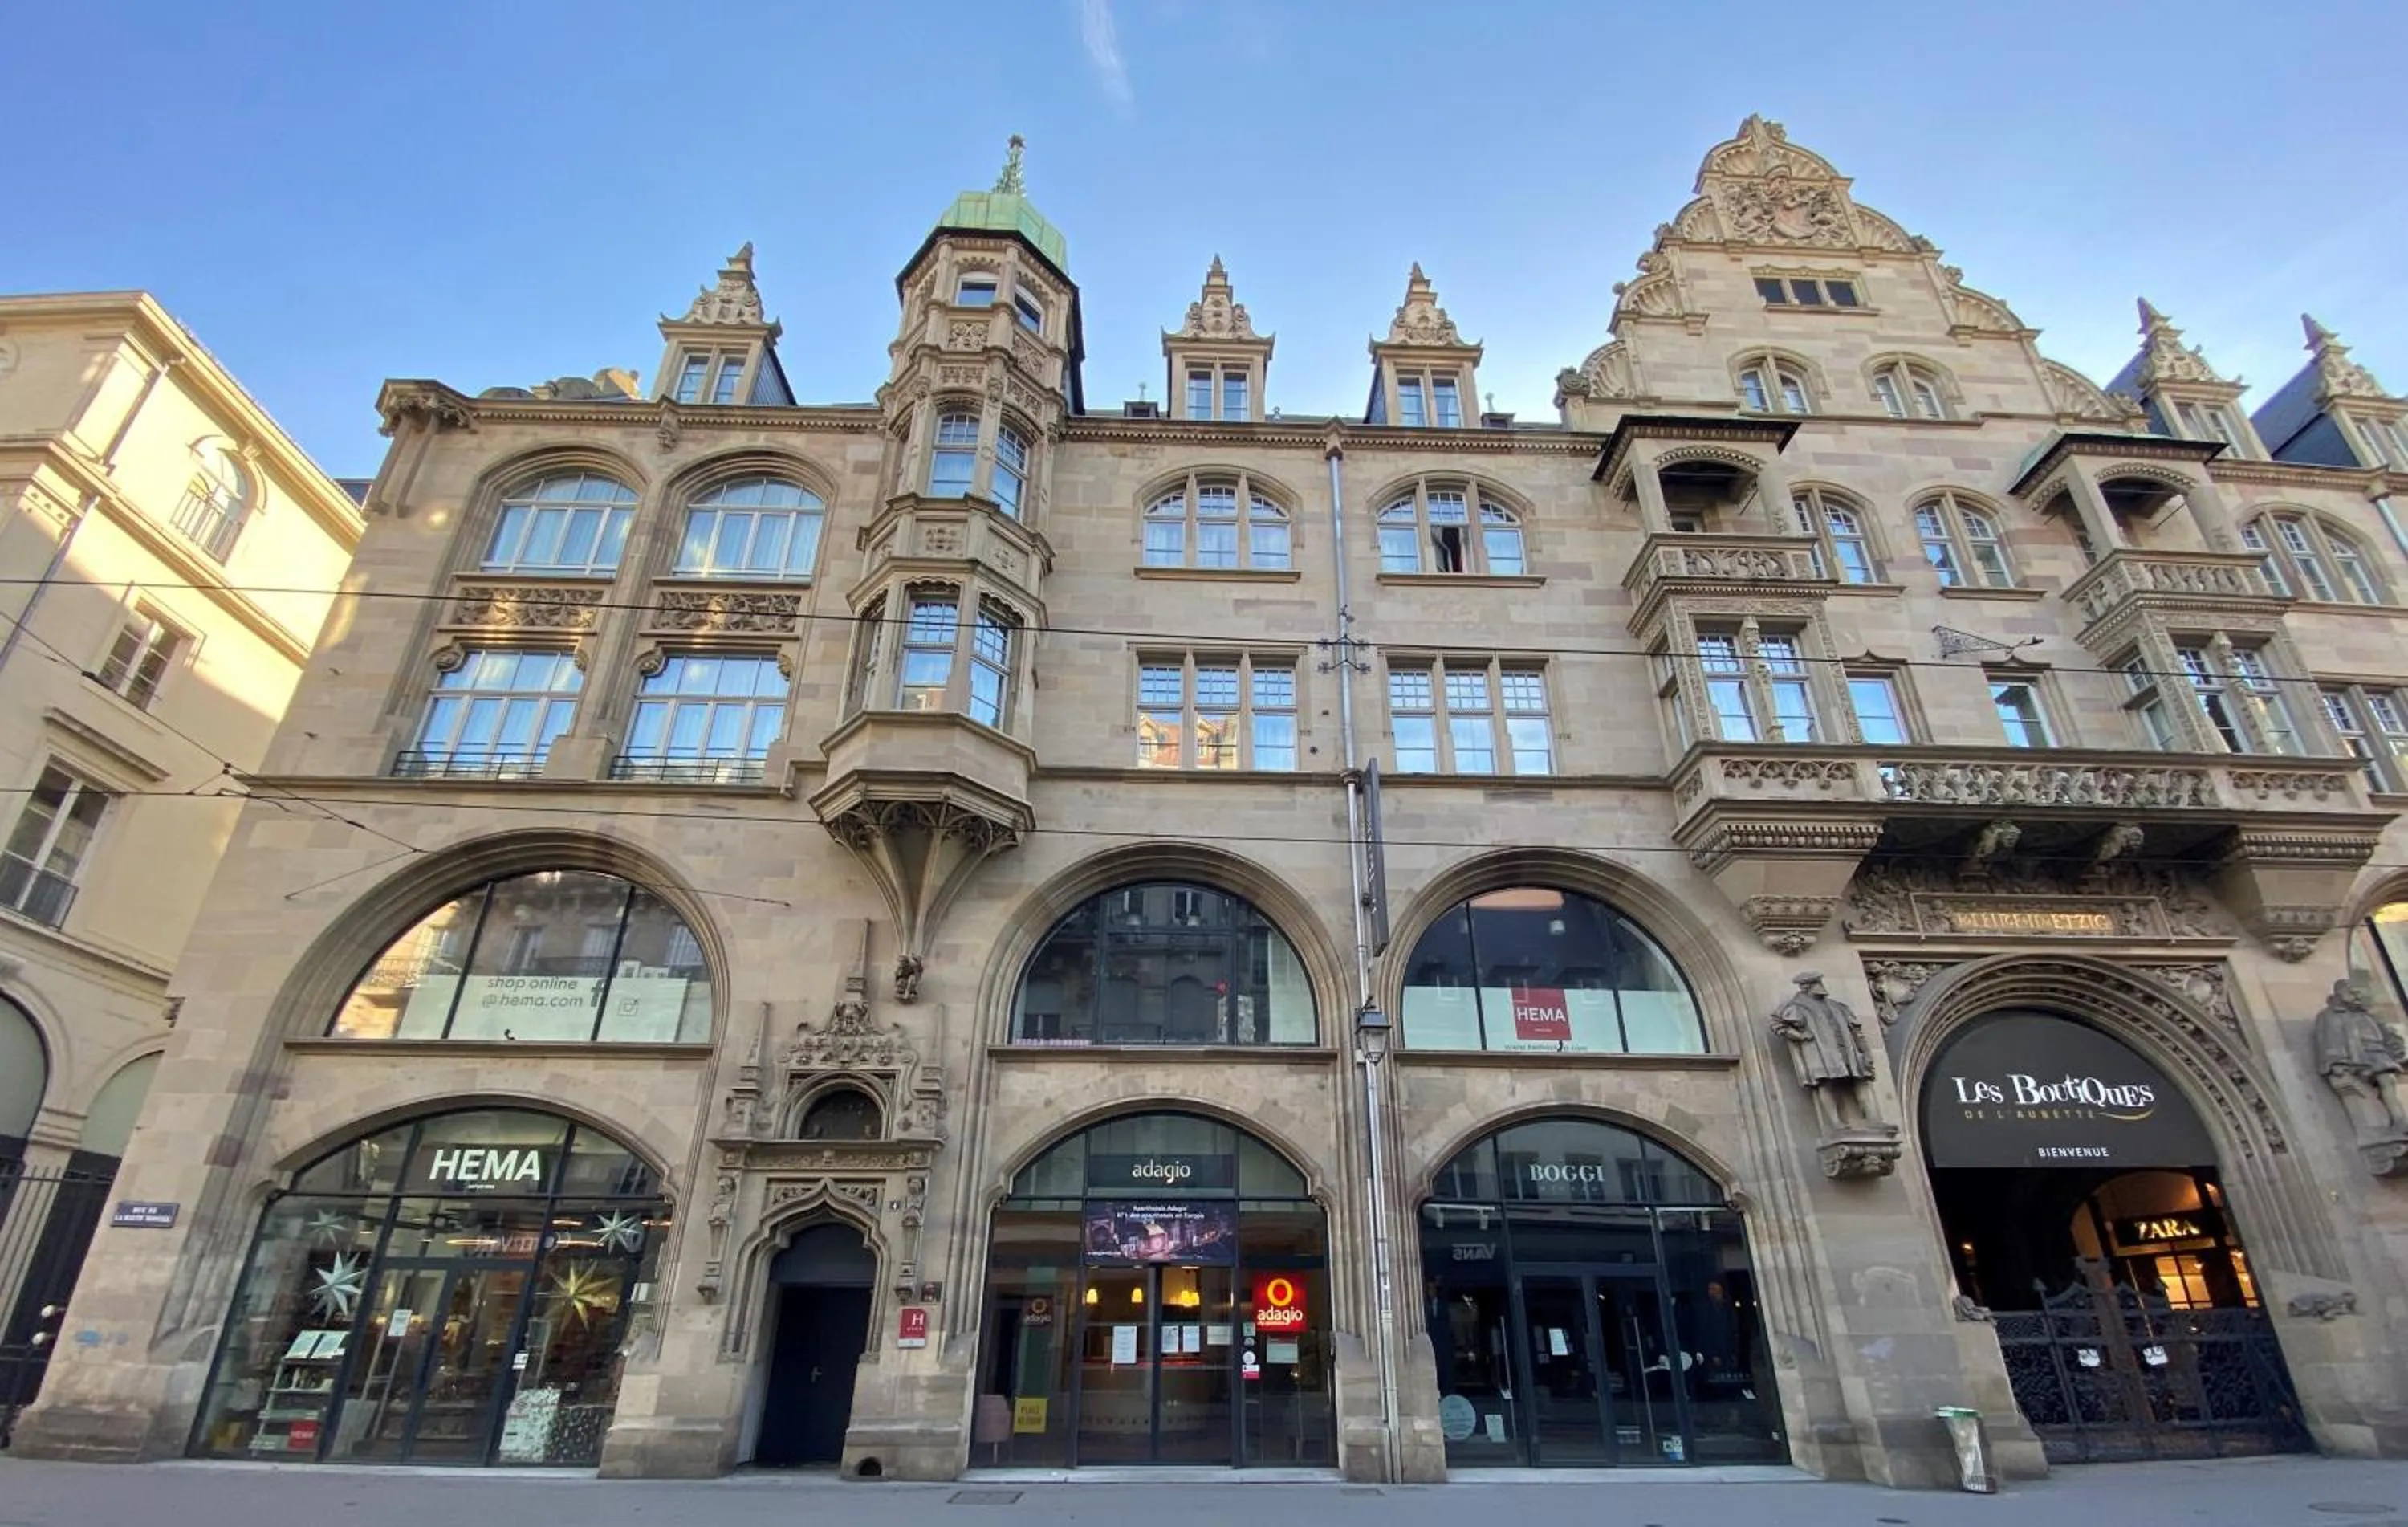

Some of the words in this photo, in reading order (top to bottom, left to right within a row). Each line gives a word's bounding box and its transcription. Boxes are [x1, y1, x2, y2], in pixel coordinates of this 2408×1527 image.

[487, 977, 526, 992] shop
[528, 977, 578, 990] online
[1516, 1007, 1566, 1022] HEMA
[1965, 1110, 1984, 1119] DE
[2038, 1147, 2110, 1158] BIENVENUE
[429, 1149, 541, 1181] HEMA
[1132, 1159, 1191, 1184] adagio
[1529, 1163, 1605, 1183] BOGGI
[2134, 1218, 2200, 1240] ZARA
[911, 1313, 925, 1325] H
[1257, 1305, 1304, 1323] adagio
